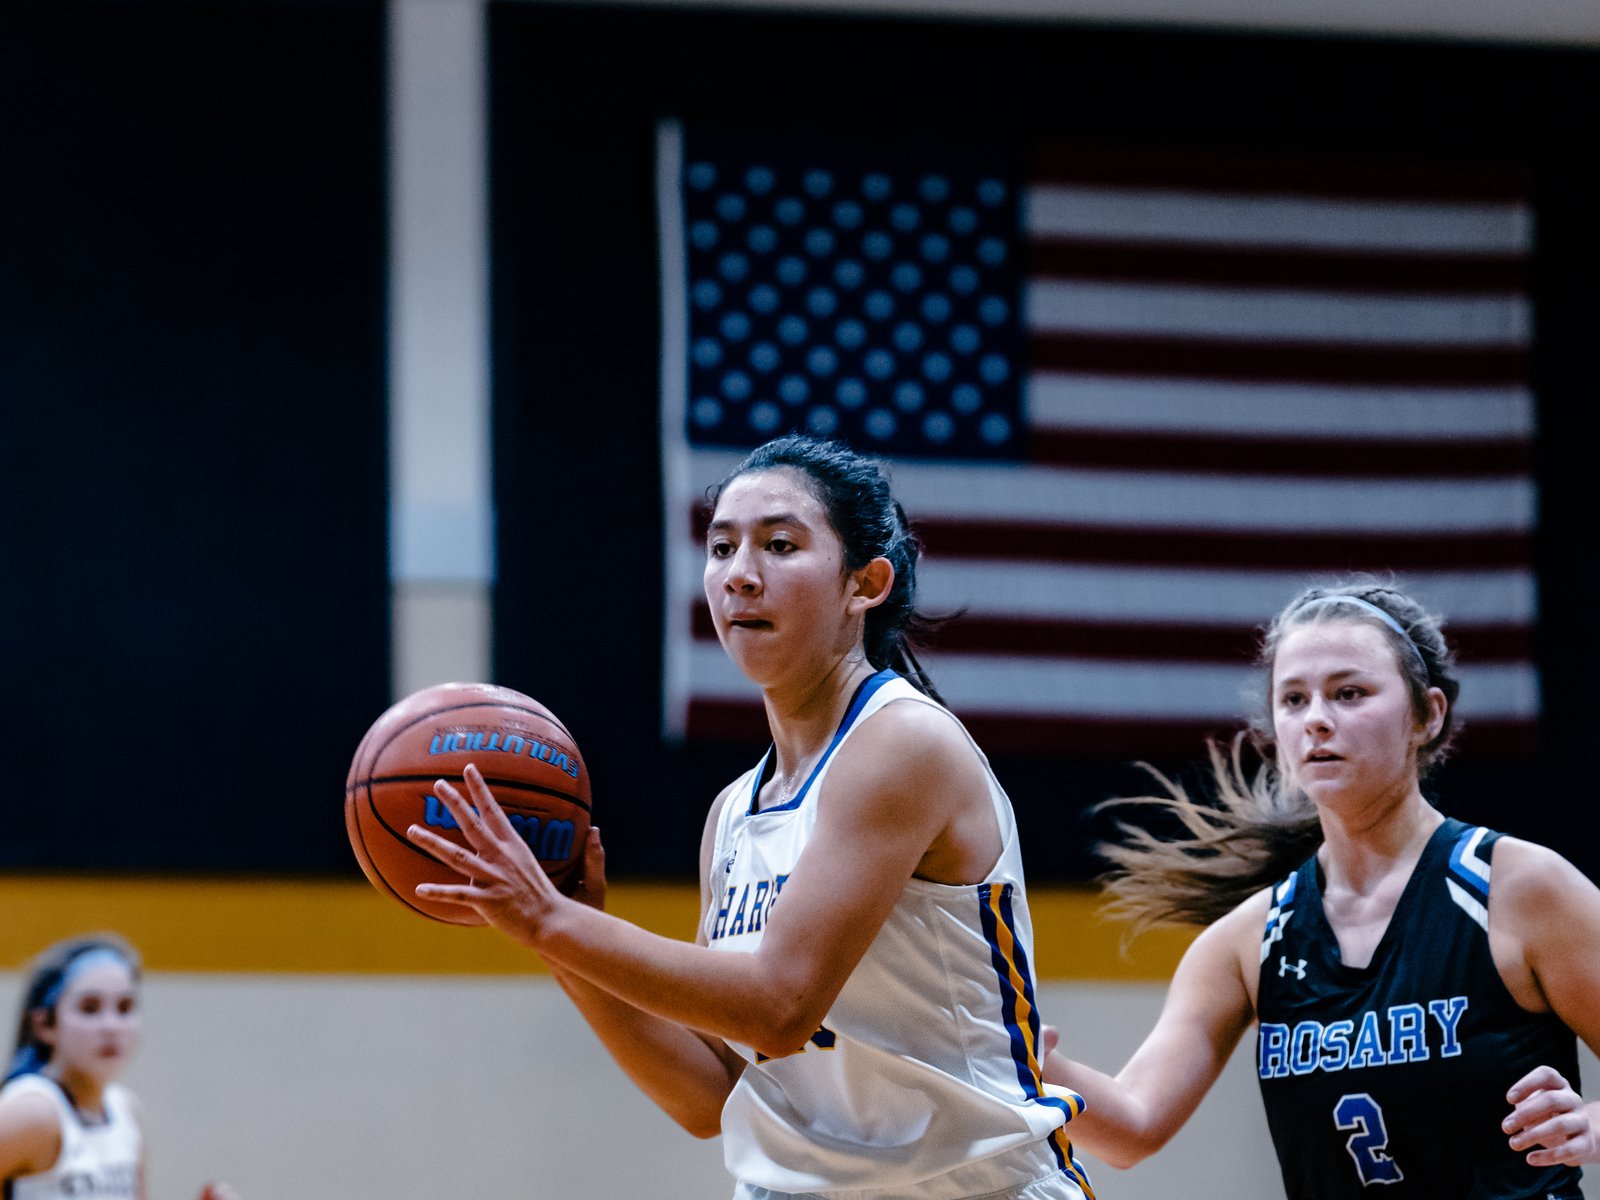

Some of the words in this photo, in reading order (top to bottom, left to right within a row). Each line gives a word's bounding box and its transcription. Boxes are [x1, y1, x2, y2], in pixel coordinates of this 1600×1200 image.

[428, 731, 579, 778] EVOLUTION
[1259, 996, 1468, 1079] ROSARY
[1333, 1093, 1404, 1187] 2
